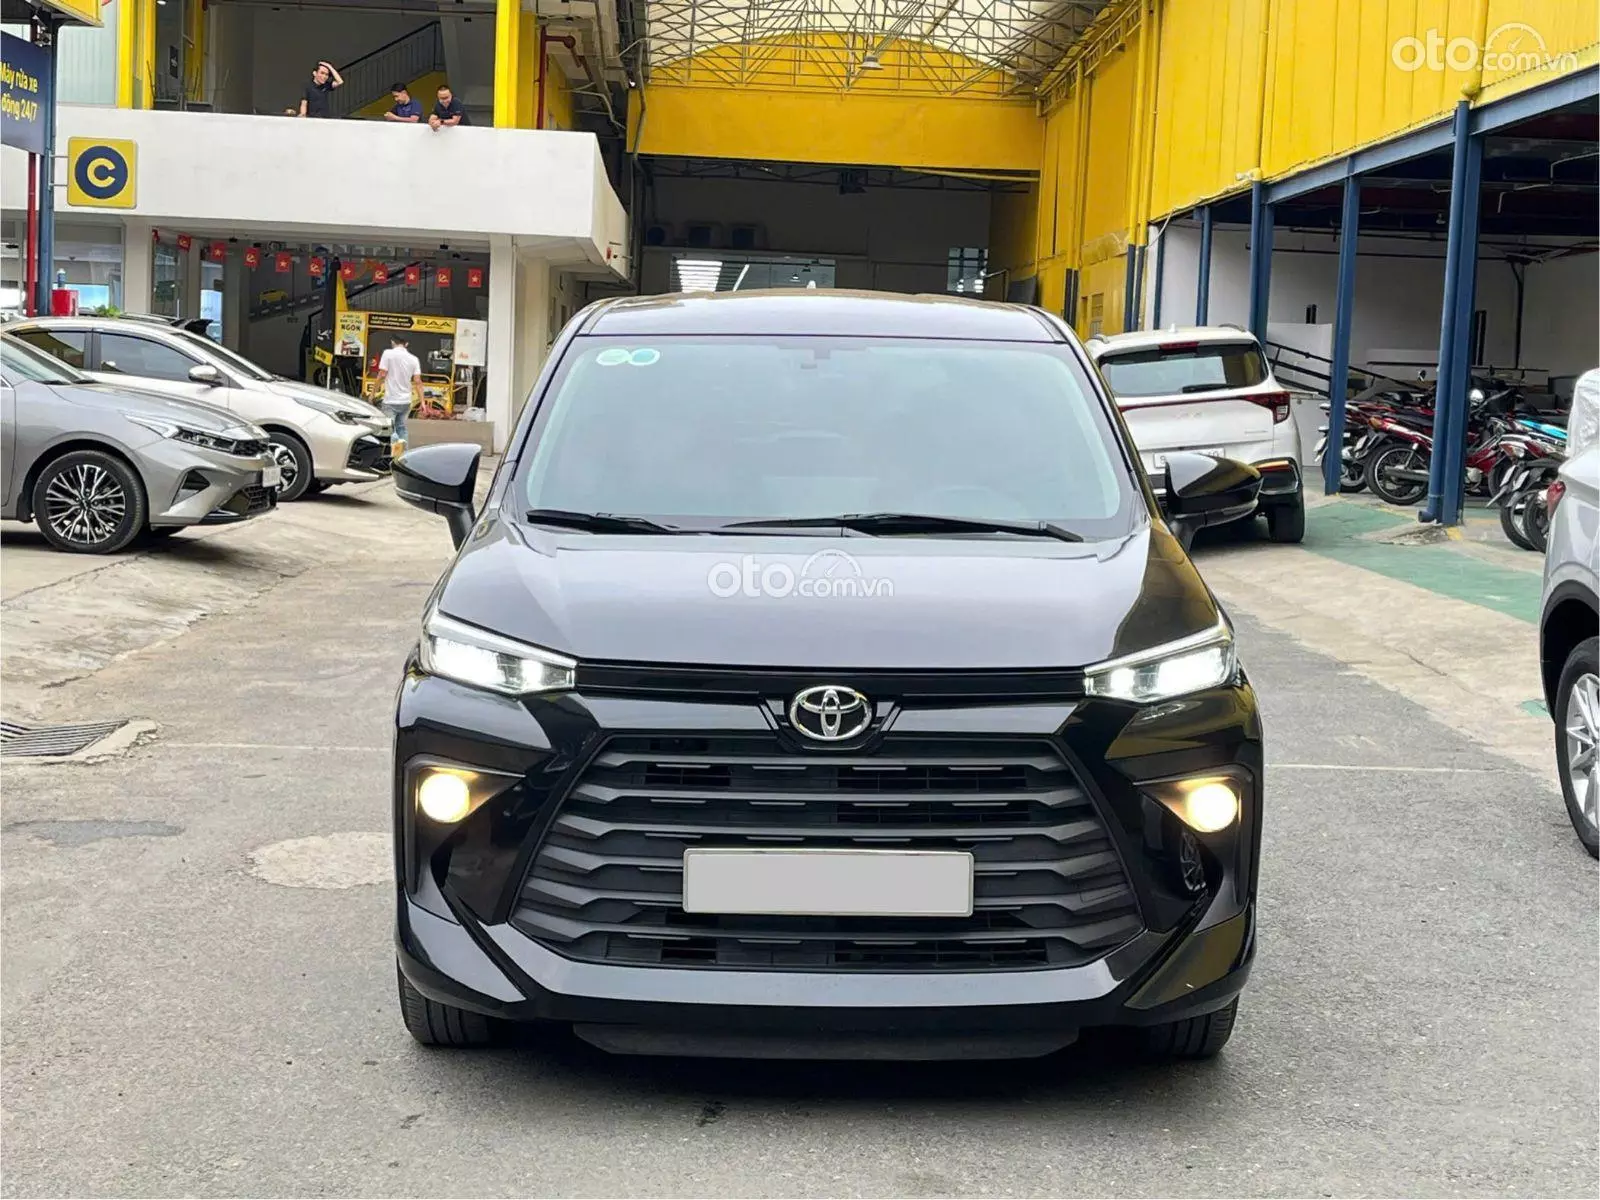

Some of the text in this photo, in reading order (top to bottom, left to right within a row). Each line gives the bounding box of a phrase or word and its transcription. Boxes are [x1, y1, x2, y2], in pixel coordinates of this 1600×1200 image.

[28, 76, 38, 93] xe
[21, 98, 37, 122] 24/7
[86, 157, 116, 188] C
